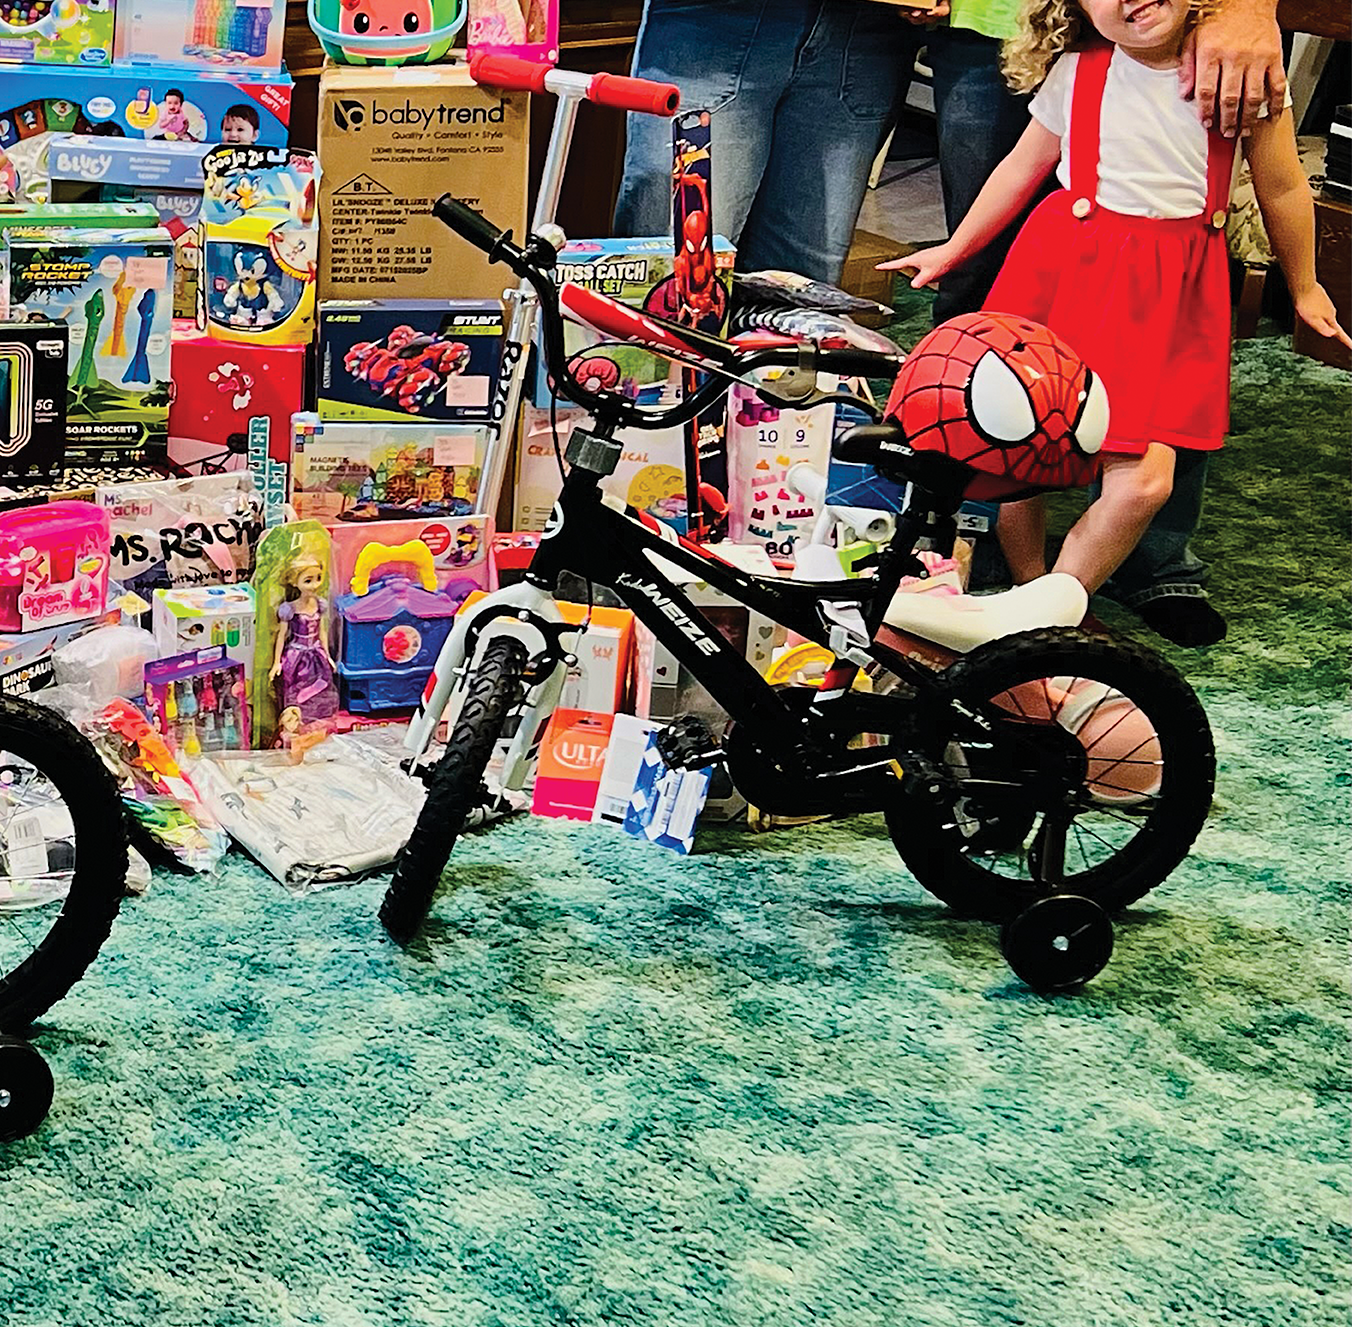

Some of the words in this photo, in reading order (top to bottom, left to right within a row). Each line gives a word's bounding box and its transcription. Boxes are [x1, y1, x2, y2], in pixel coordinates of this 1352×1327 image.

[260, 93, 281, 111] GIFT!
[264, 84, 289, 107] GREAT
[372, 98, 504, 131] babytrend
[392, 131, 423, 140] Quality
[434, 131, 471, 140] Comfort
[482, 130, 503, 140] Style
[468, 145, 481, 154] CA
[353, 182, 378, 193] B.T.
[29, 263, 91, 272] STOMP
[555, 264, 595, 284] TOSS
[596, 261, 647, 282] CATCH
[21, 271, 93, 281] ROCKET
[331, 275, 356, 283] MADE
[368, 275, 396, 283] CHINA
[579, 280, 602, 294] ALL
[604, 280, 623, 294] SET
[34, 398, 54, 411] 5G
[93, 425, 138, 435] ROCKETS
[758, 429, 779, 443] 10
[795, 429, 806, 443] 9
[765, 541, 794, 556] 80
